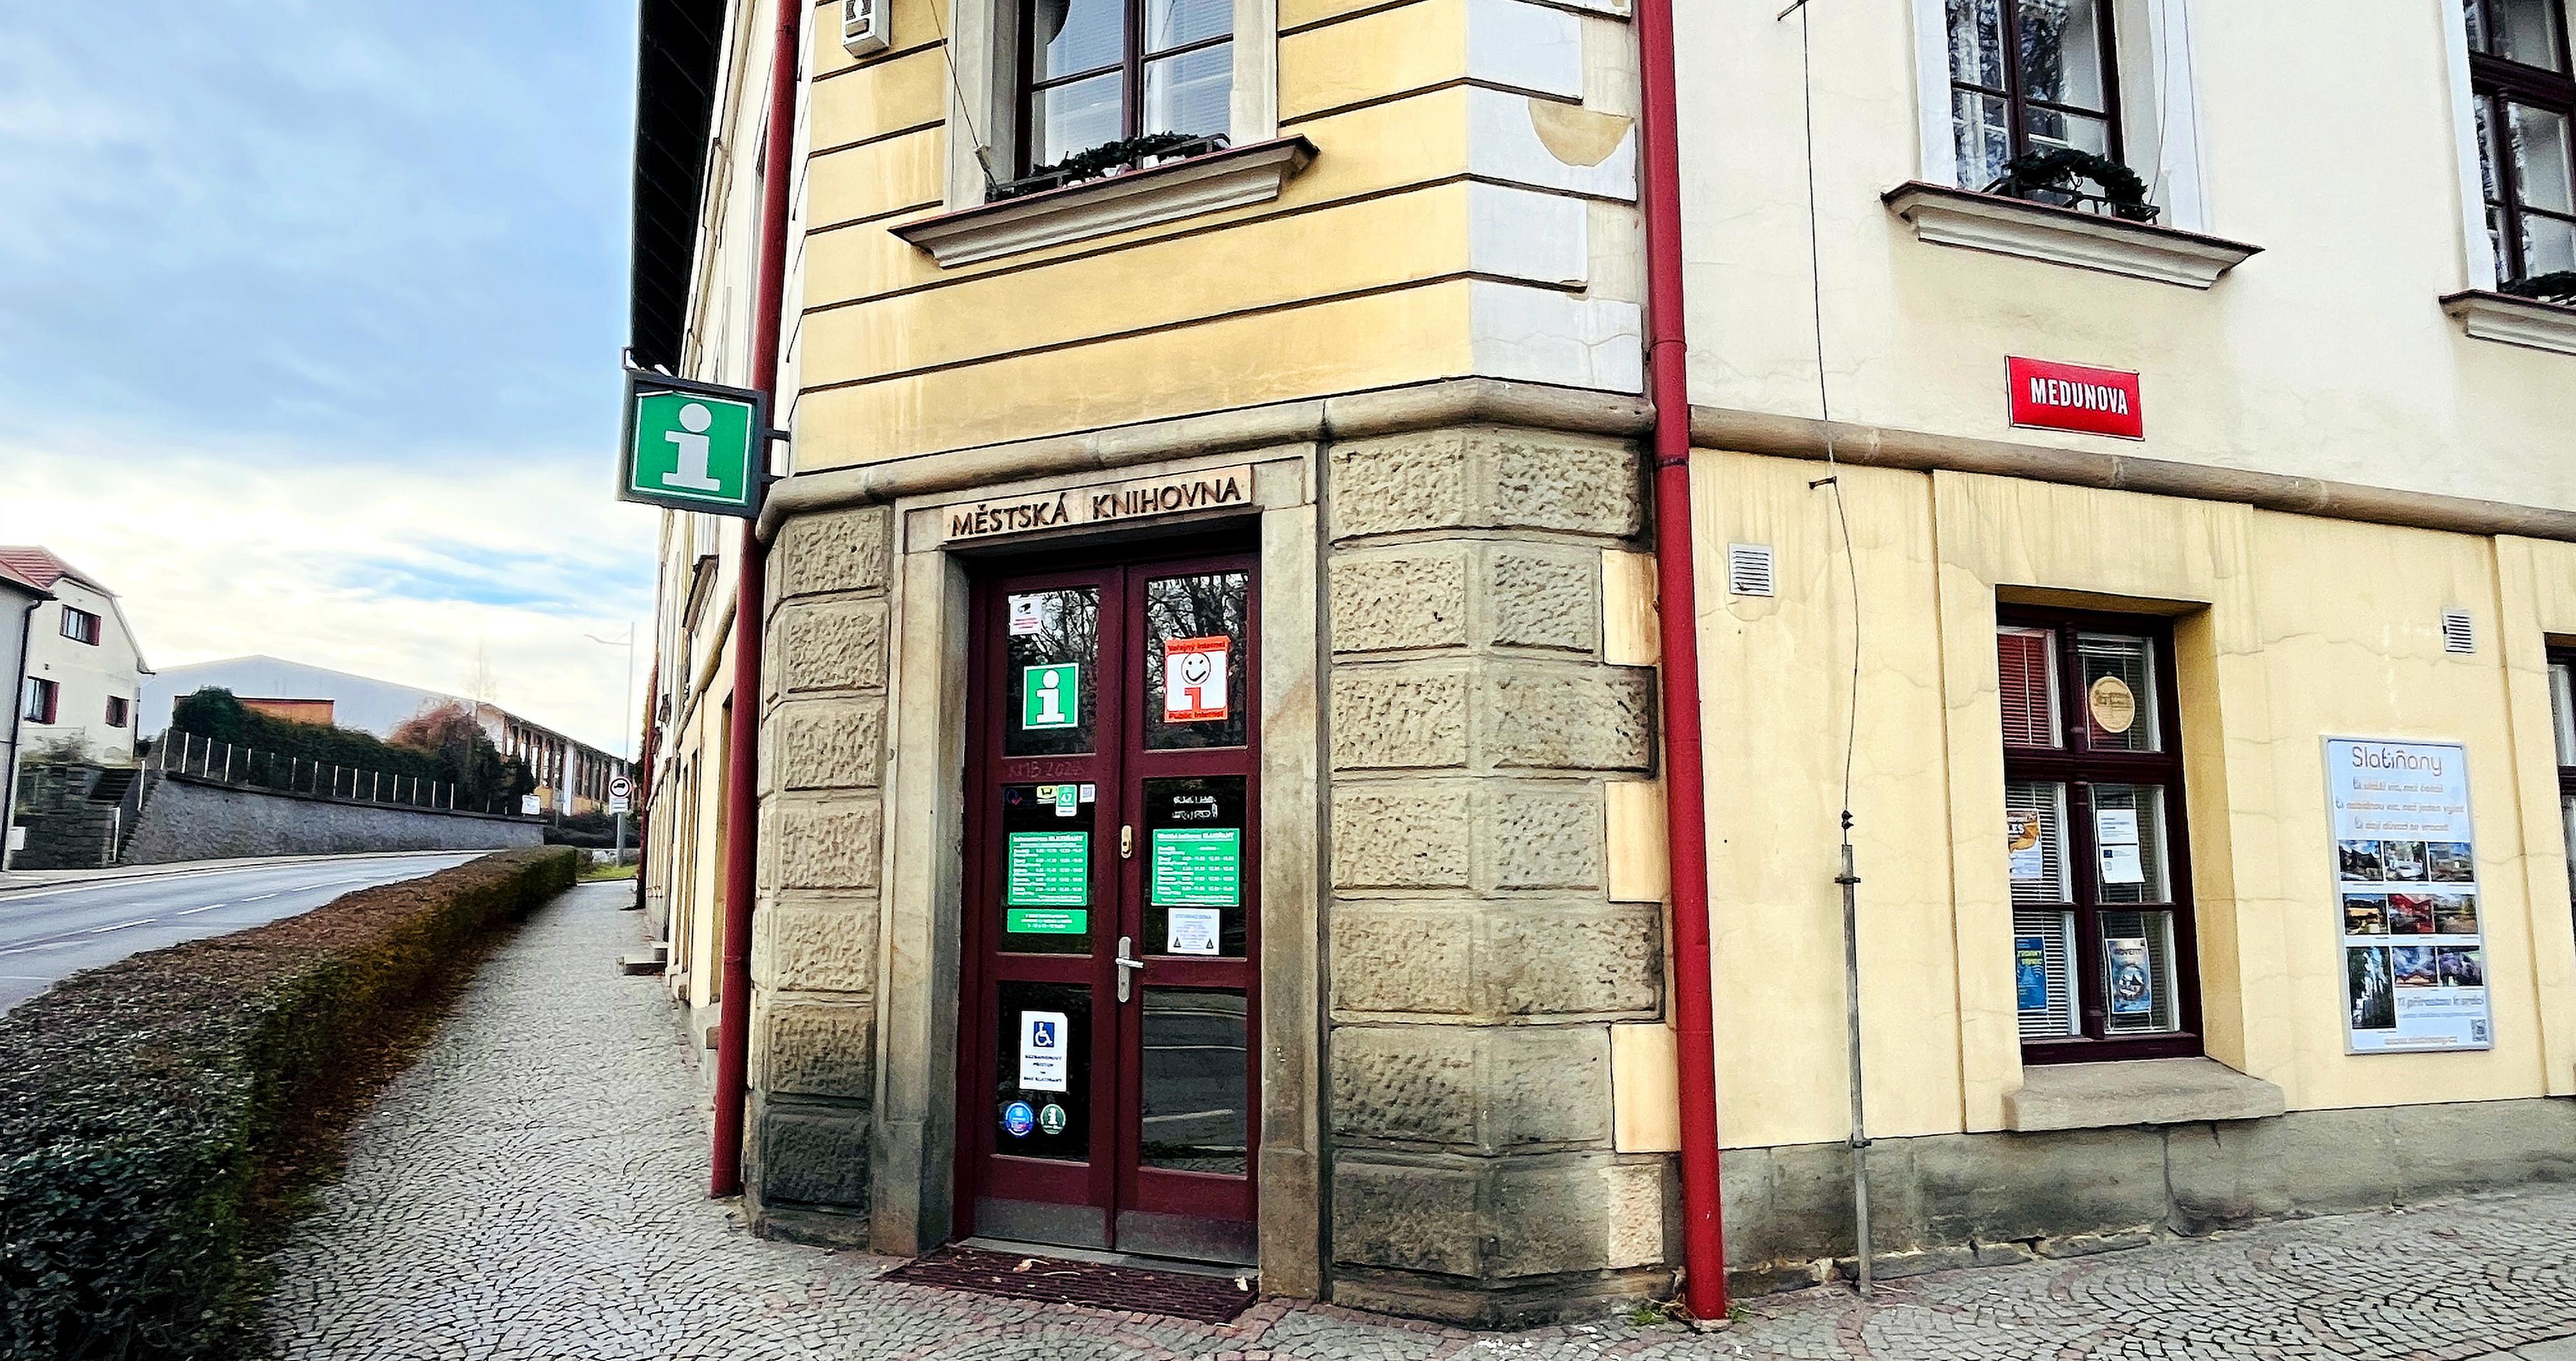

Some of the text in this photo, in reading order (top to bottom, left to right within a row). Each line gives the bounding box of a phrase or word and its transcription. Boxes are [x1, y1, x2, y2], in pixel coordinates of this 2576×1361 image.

[2030, 377, 2128, 415] MEDUNOVA
[951, 476, 1242, 537] MĚSTSKÁ KNIHOVNA
[2352, 746, 2443, 776] Slatiňany
